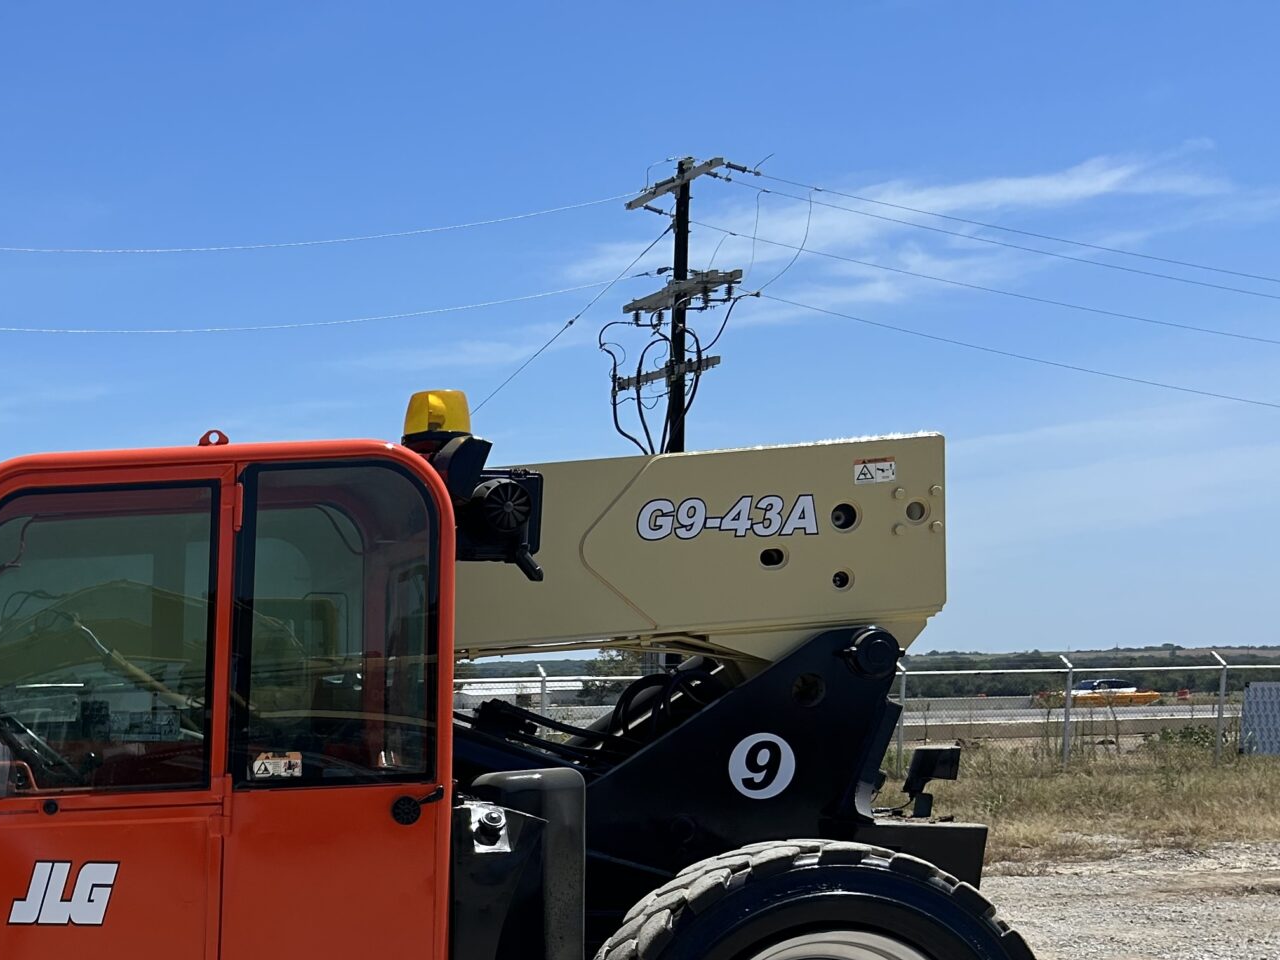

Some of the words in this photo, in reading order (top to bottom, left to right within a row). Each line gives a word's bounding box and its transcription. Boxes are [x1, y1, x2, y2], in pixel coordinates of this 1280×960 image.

[636, 494, 819, 541] G9-43A
[741, 740, 782, 791] 9
[7, 860, 120, 926] JLG
